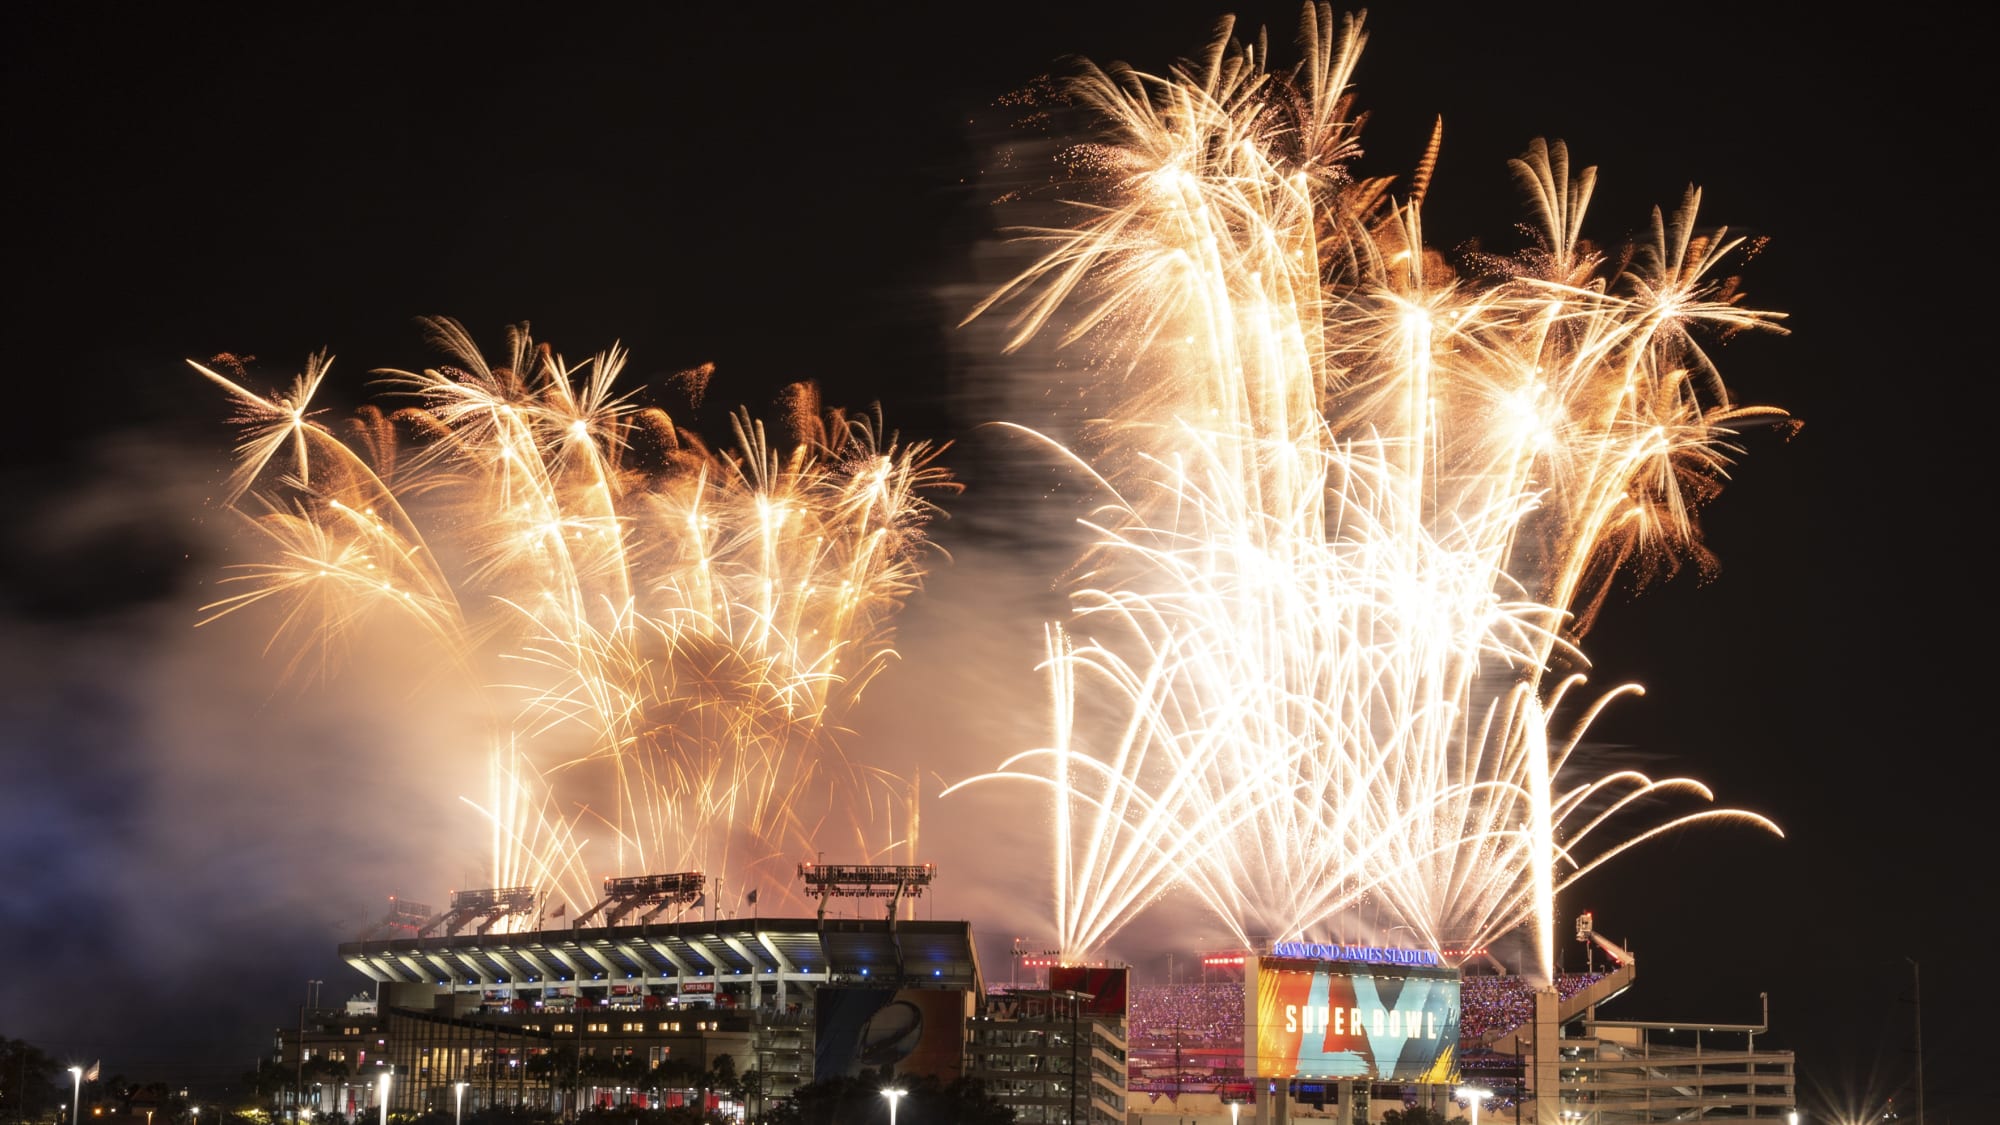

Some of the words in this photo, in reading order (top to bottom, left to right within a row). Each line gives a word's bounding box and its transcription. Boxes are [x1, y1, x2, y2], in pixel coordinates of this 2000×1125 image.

[1275, 942, 1340, 959] RAYMOND
[1341, 945, 1383, 961] JAMES
[1383, 949, 1438, 965] STADIUM
[1285, 1004, 1363, 1036] SUPER
[1373, 1008, 1438, 1040] BOWL
